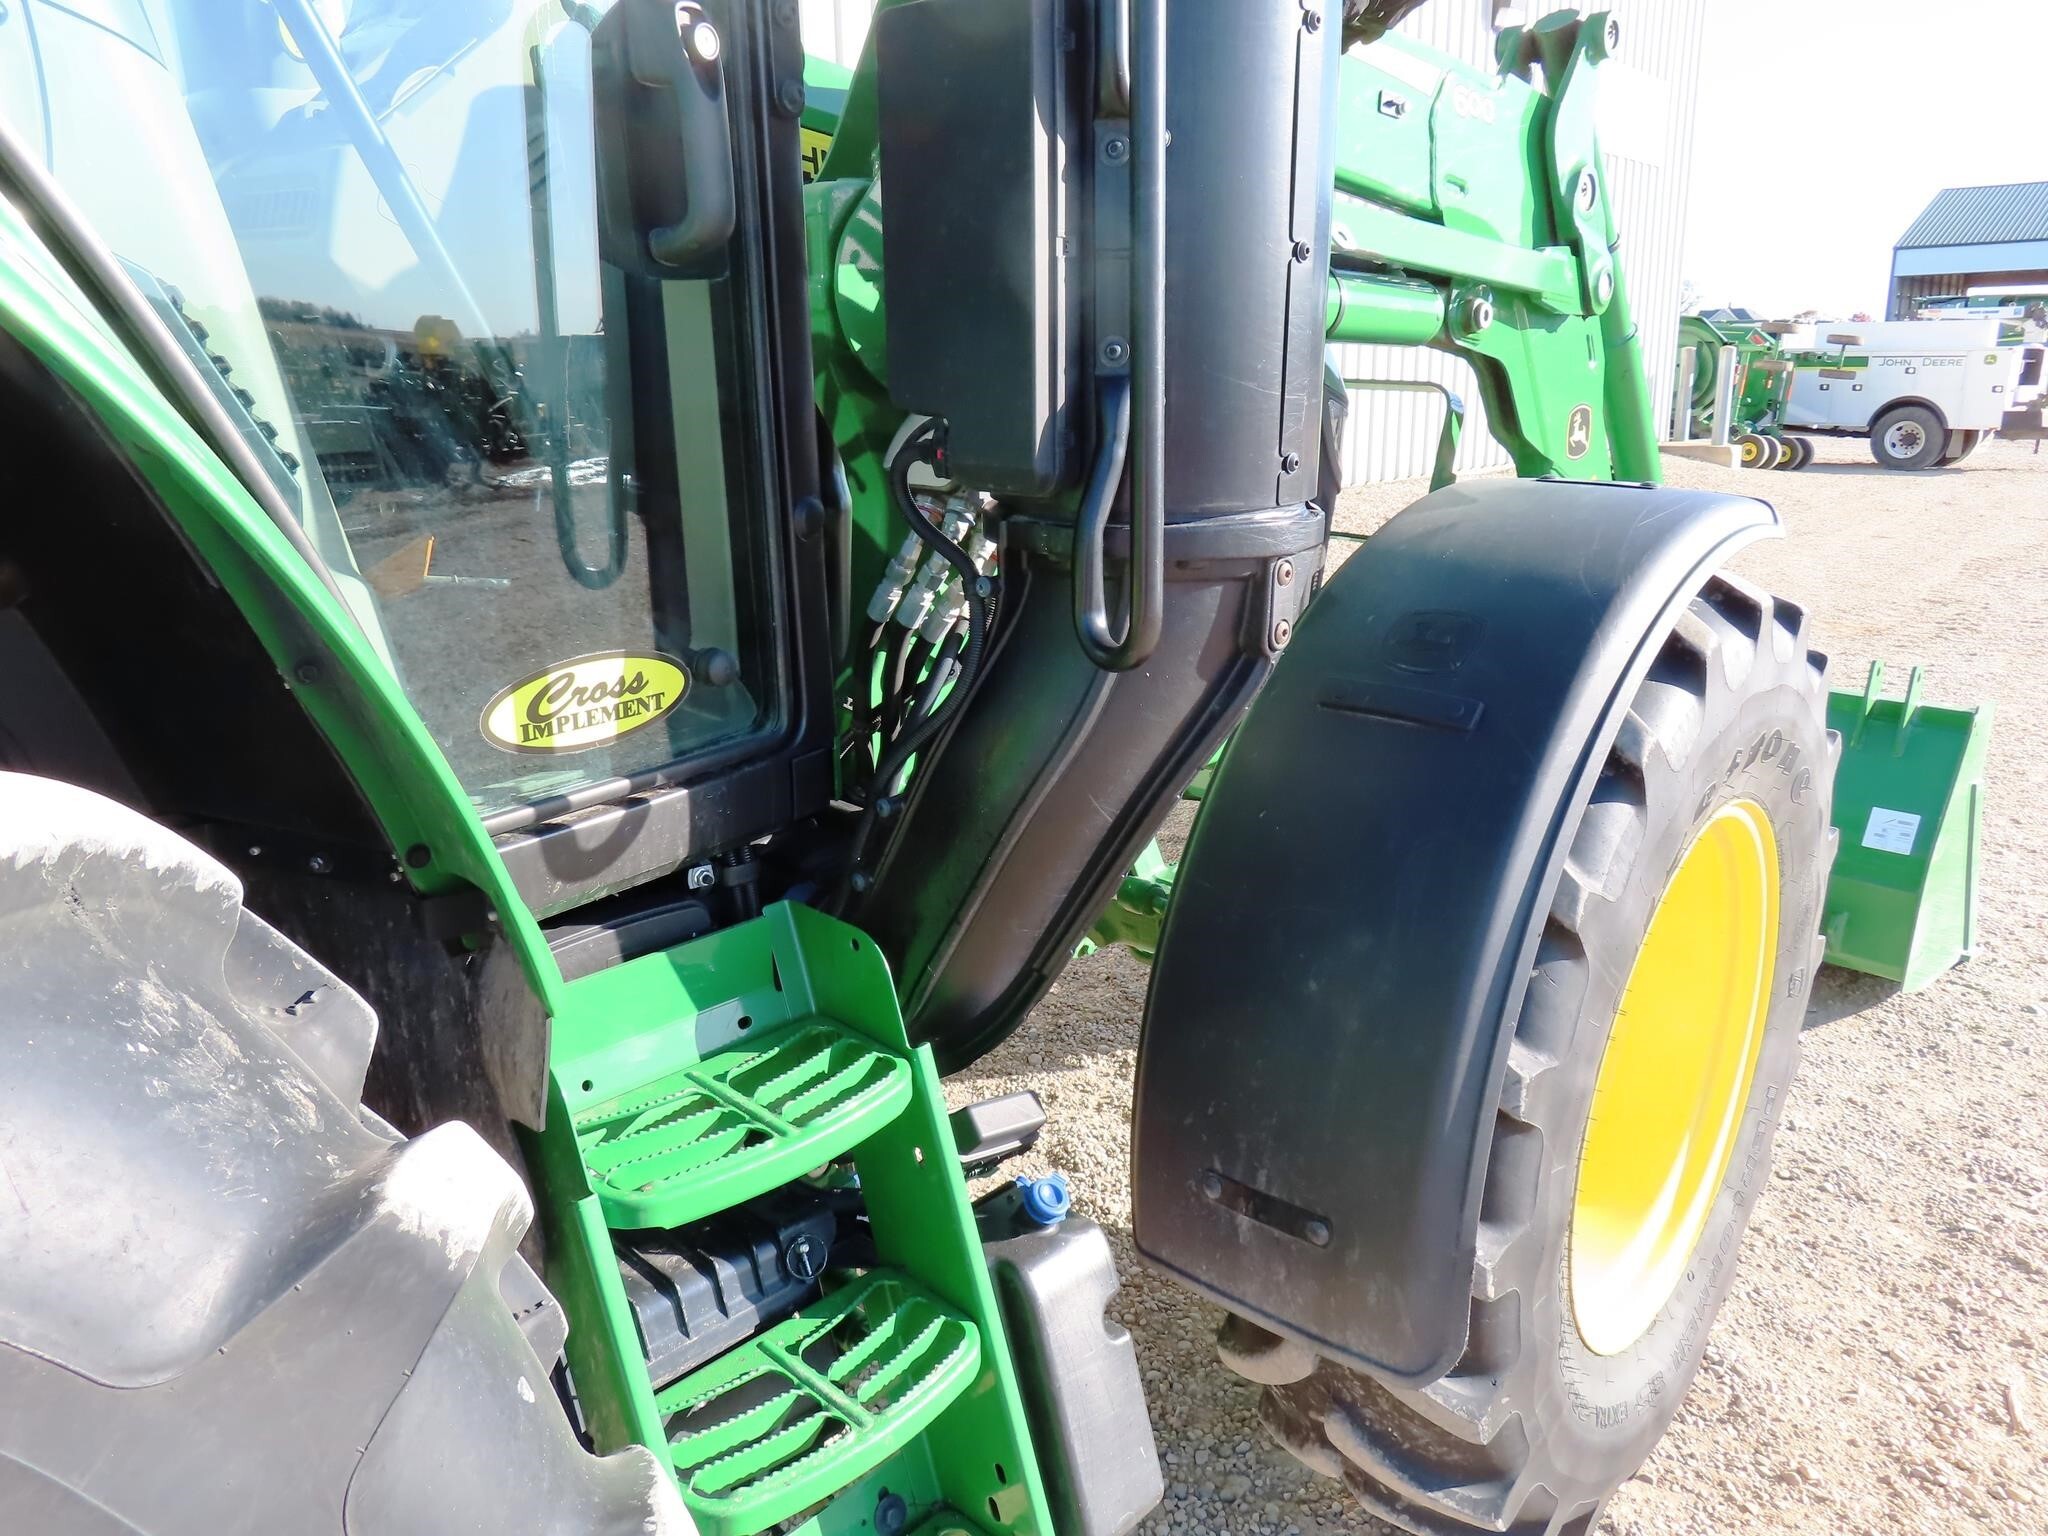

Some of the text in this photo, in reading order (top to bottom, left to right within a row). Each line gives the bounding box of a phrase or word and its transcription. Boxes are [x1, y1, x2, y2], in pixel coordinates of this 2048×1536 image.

[1878, 357, 1964, 367] JOHN DEERE
[519, 691, 666, 743] IMPLEMENT
[526, 670, 649, 725] Cross
